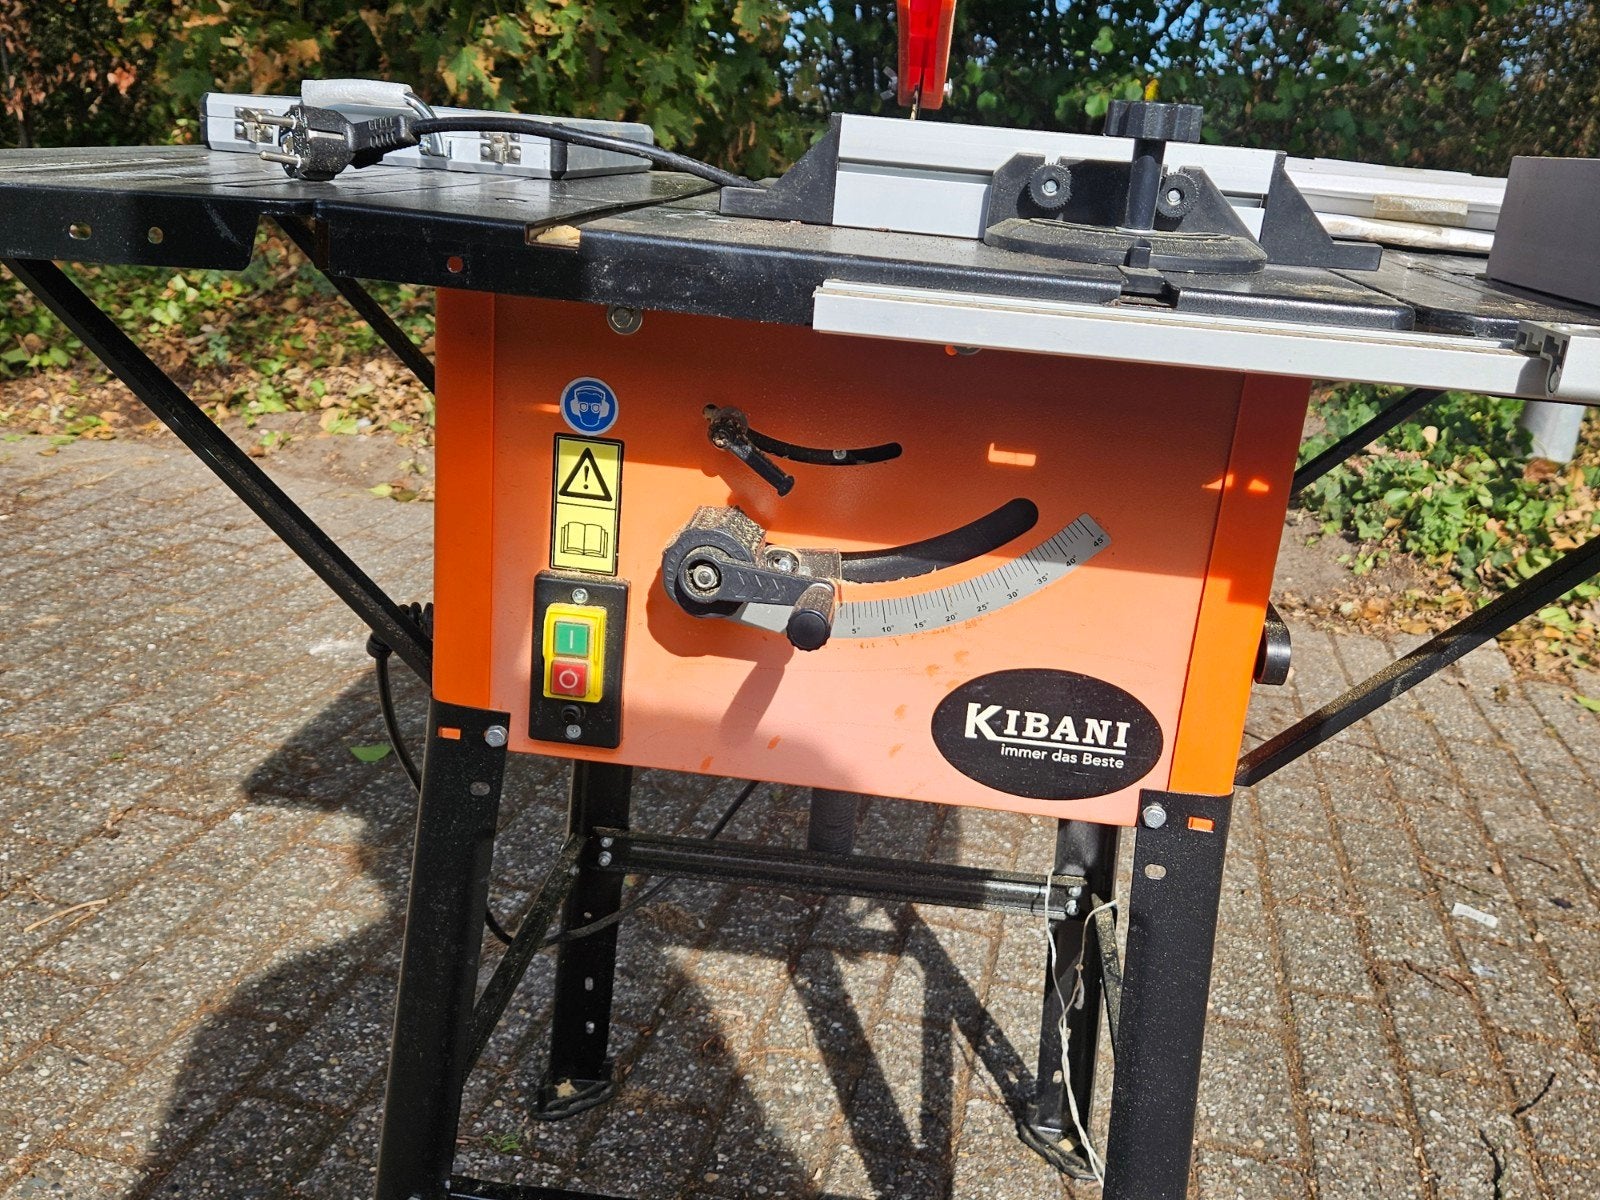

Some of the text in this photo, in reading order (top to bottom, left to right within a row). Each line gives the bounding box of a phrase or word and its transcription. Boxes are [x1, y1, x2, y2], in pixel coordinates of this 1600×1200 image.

[964, 702, 1131, 748] KIBANI
[1000, 743, 1125, 768] immer das Beste
